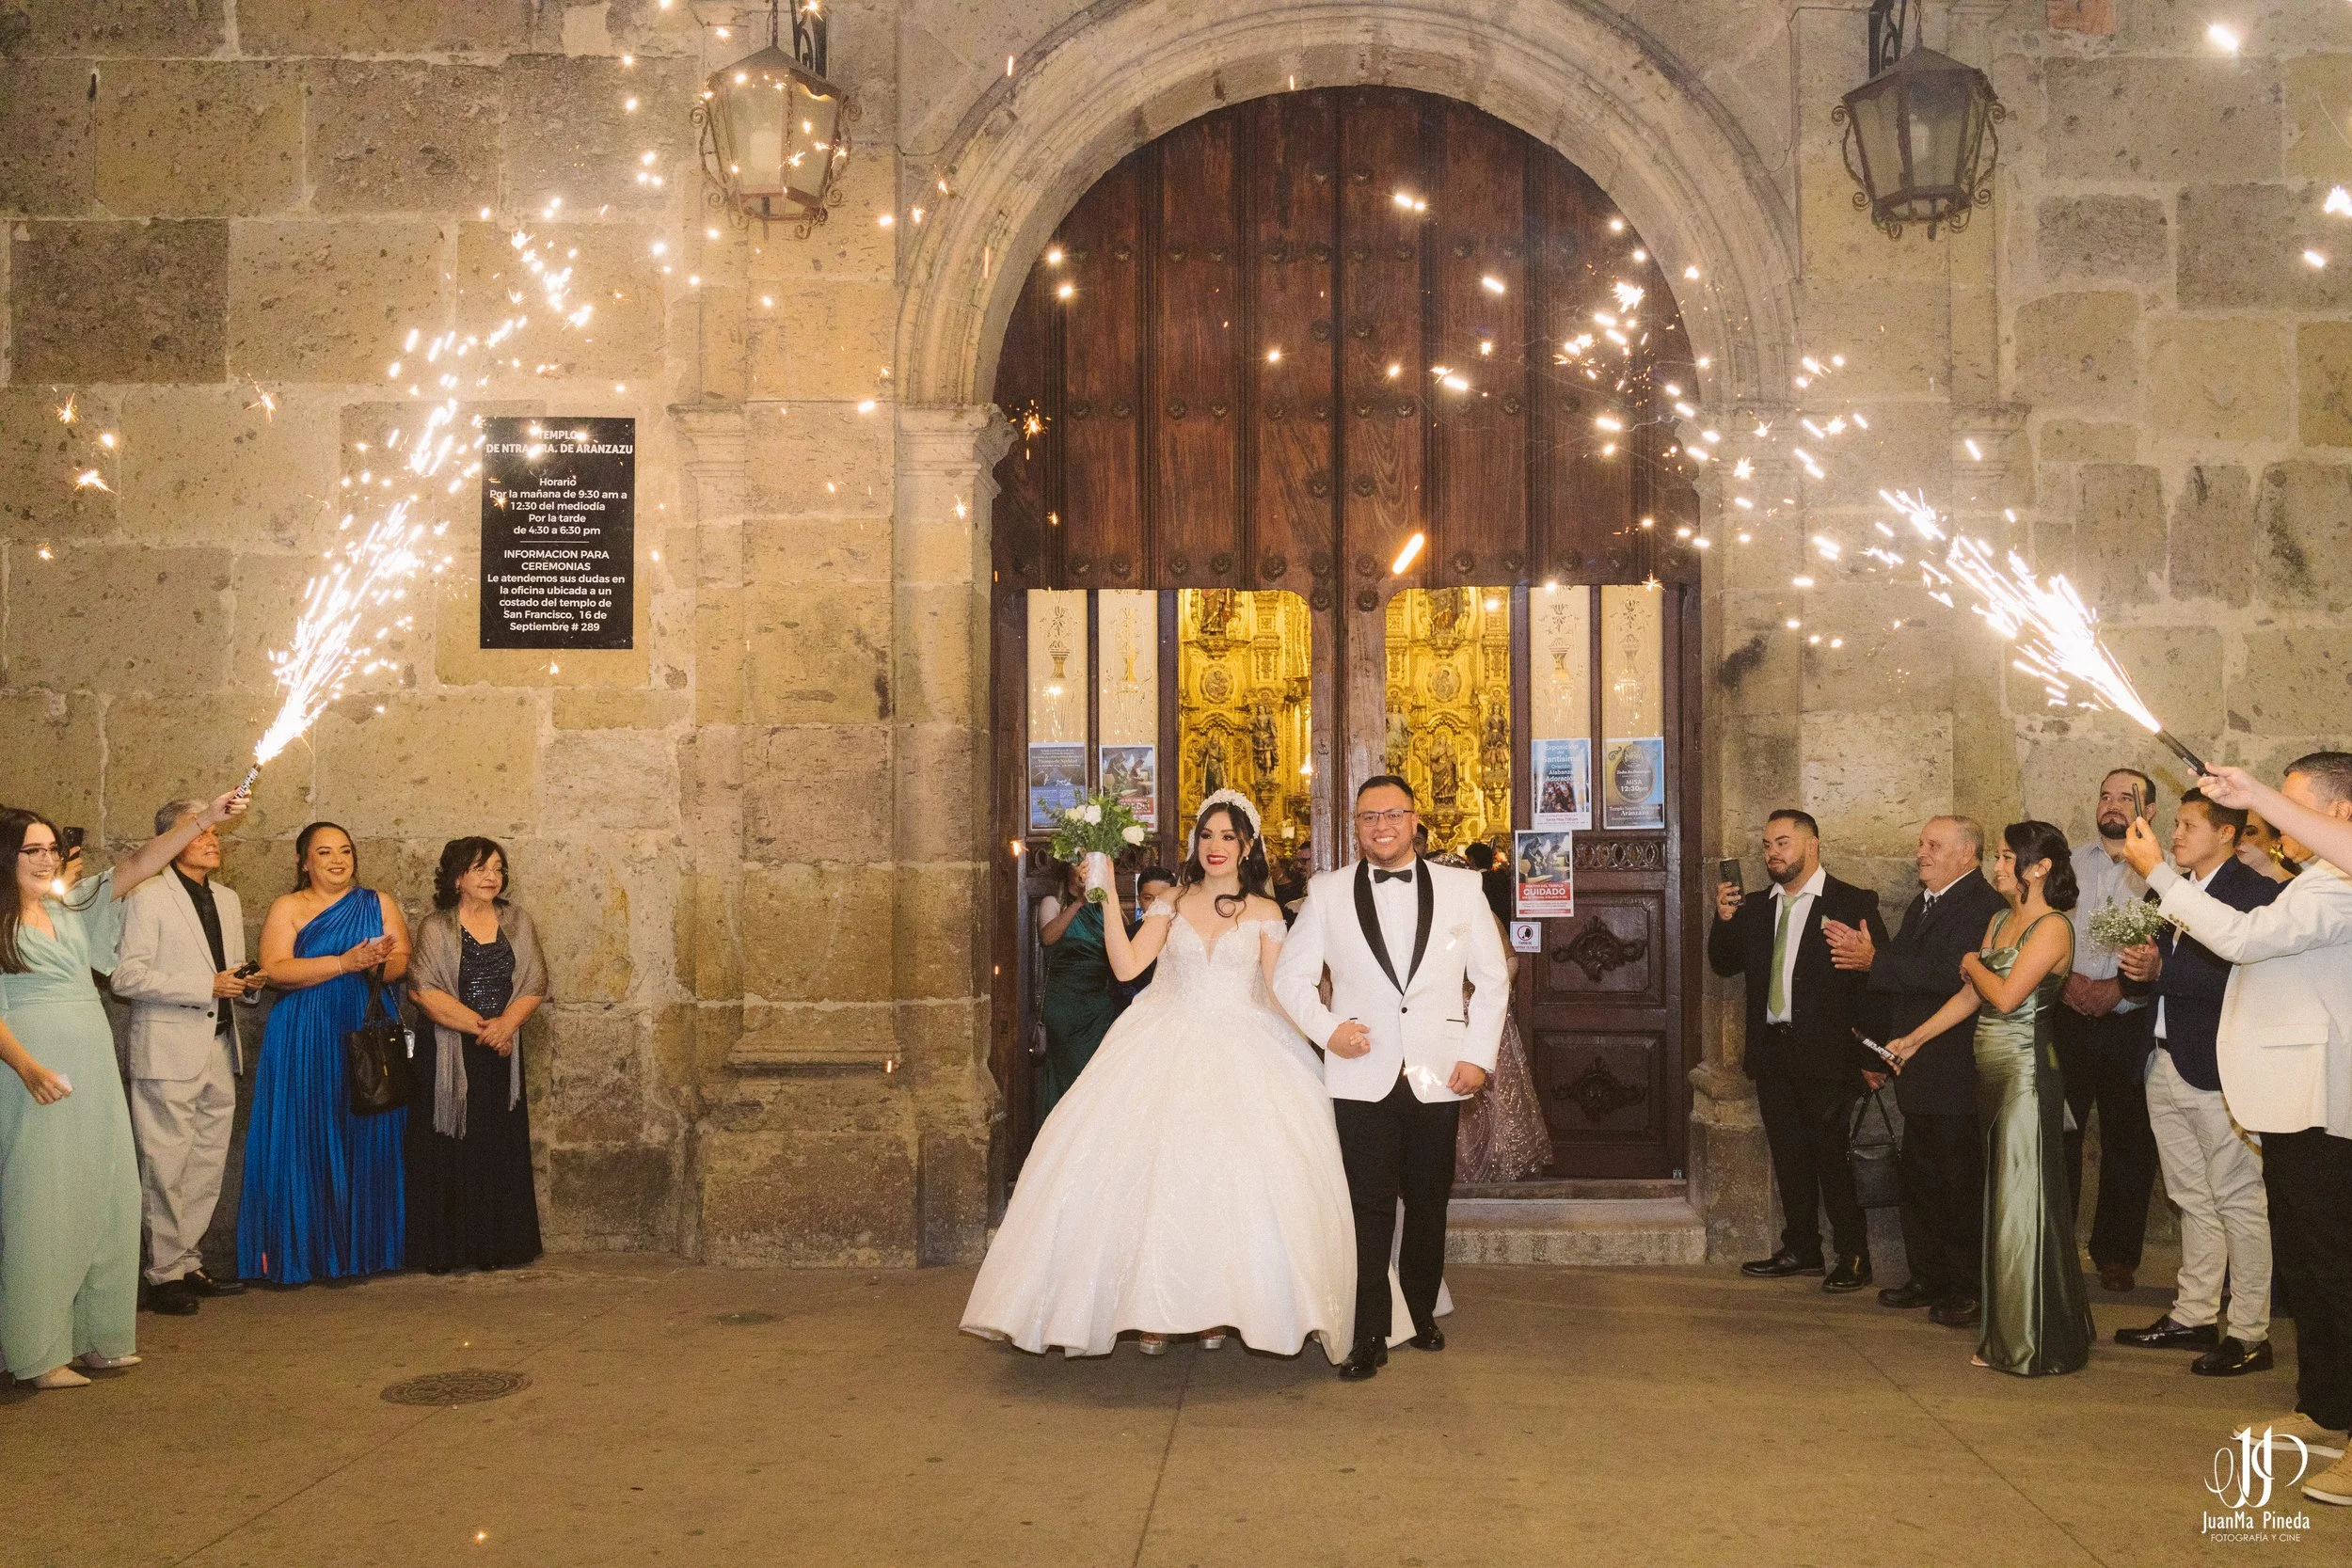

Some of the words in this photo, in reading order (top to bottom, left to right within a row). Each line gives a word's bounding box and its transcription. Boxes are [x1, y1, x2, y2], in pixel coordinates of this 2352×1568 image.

[538, 430, 578, 440] TEMPLO
[486, 443, 500, 453] DE
[560, 443, 575, 453] DE
[576, 443, 633, 454] ARANZAZU
[540, 477, 577, 486] Horario
[490, 490, 507, 499] Por
[509, 490, 518, 499] la
[520, 490, 561, 499] mañana
[563, 490, 576, 499] de
[579, 490, 600, 499] 9:30
[511, 501, 537, 510] 12:30
[539, 501, 555, 511] del
[557, 501, 605, 511] mediodía
[529, 514, 546, 523] Por
[548, 514, 557, 523] la
[559, 514, 587, 523] tarde
[514, 526, 526, 534] de
[528, 526, 549, 535] 4:30
[560, 526, 581, 535] 6:30
[583, 528, 601, 537] pm
[504, 550, 578, 559] INFORMACION
[580, 550, 610, 559] PARA
[522, 562, 591, 571] CEREMONIAS
[487, 574, 499, 583] Le
[501, 574, 558, 583] atendemos
[578, 574, 610, 583] dudas
[500, 586, 509, 594] la
[511, 586, 545, 594] oficina
[547, 586, 588, 595] ubicada
[499, 598, 539, 607] costado
[541, 598, 557, 607] del
[559, 599, 596, 609] templo
[598, 599, 612, 607] de
[503, 610, 523, 619] San
[524, 610, 574, 620] Francisco,
[580, 611, 591, 619] 16
[594, 611, 607, 619] de
[510, 622, 569, 632] Septiembre
[571, 623, 580, 631] #
[1524, 888, 1566, 896] CUIDADO
